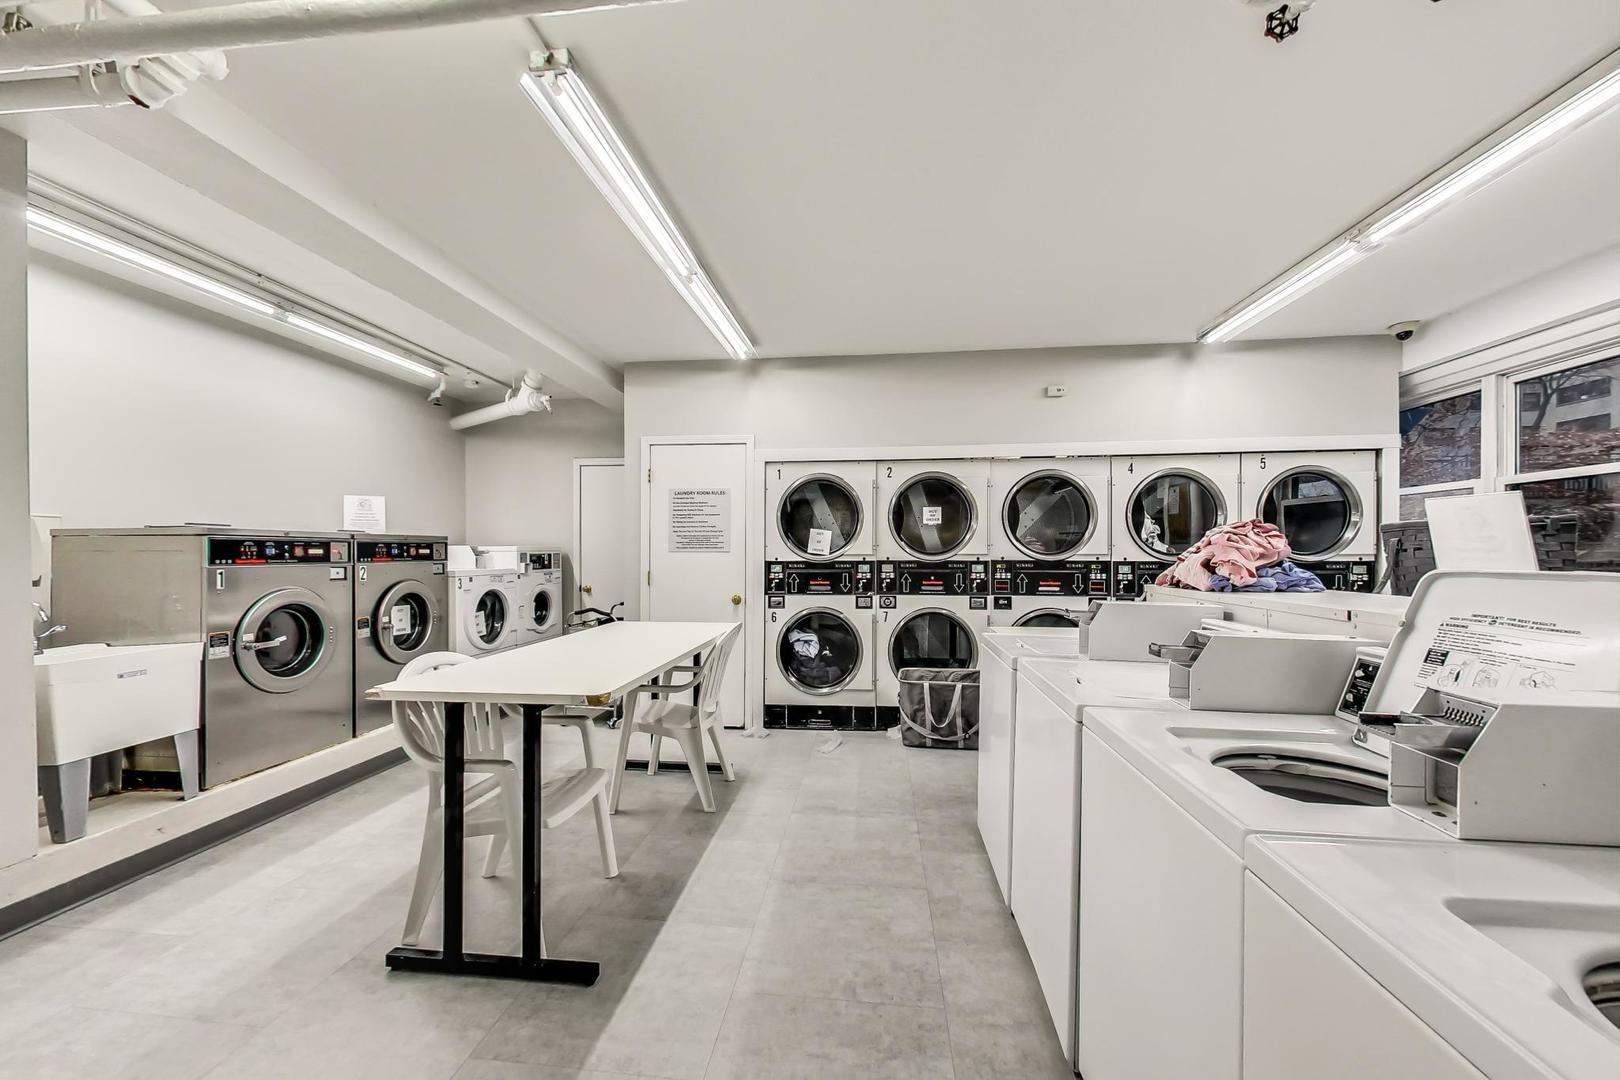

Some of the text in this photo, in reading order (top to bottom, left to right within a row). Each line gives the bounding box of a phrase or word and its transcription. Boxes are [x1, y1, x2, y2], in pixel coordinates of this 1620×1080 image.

[1127, 462, 1134, 475] 4
[1260, 457, 1266, 470] 5
[777, 468, 781, 480] 1
[886, 466, 893, 479] 2
[218, 571, 224, 588] 1
[360, 566, 367, 581] 2
[457, 577, 463, 590] 3
[771, 612, 777, 623] 6
[883, 611, 889, 623] 7
